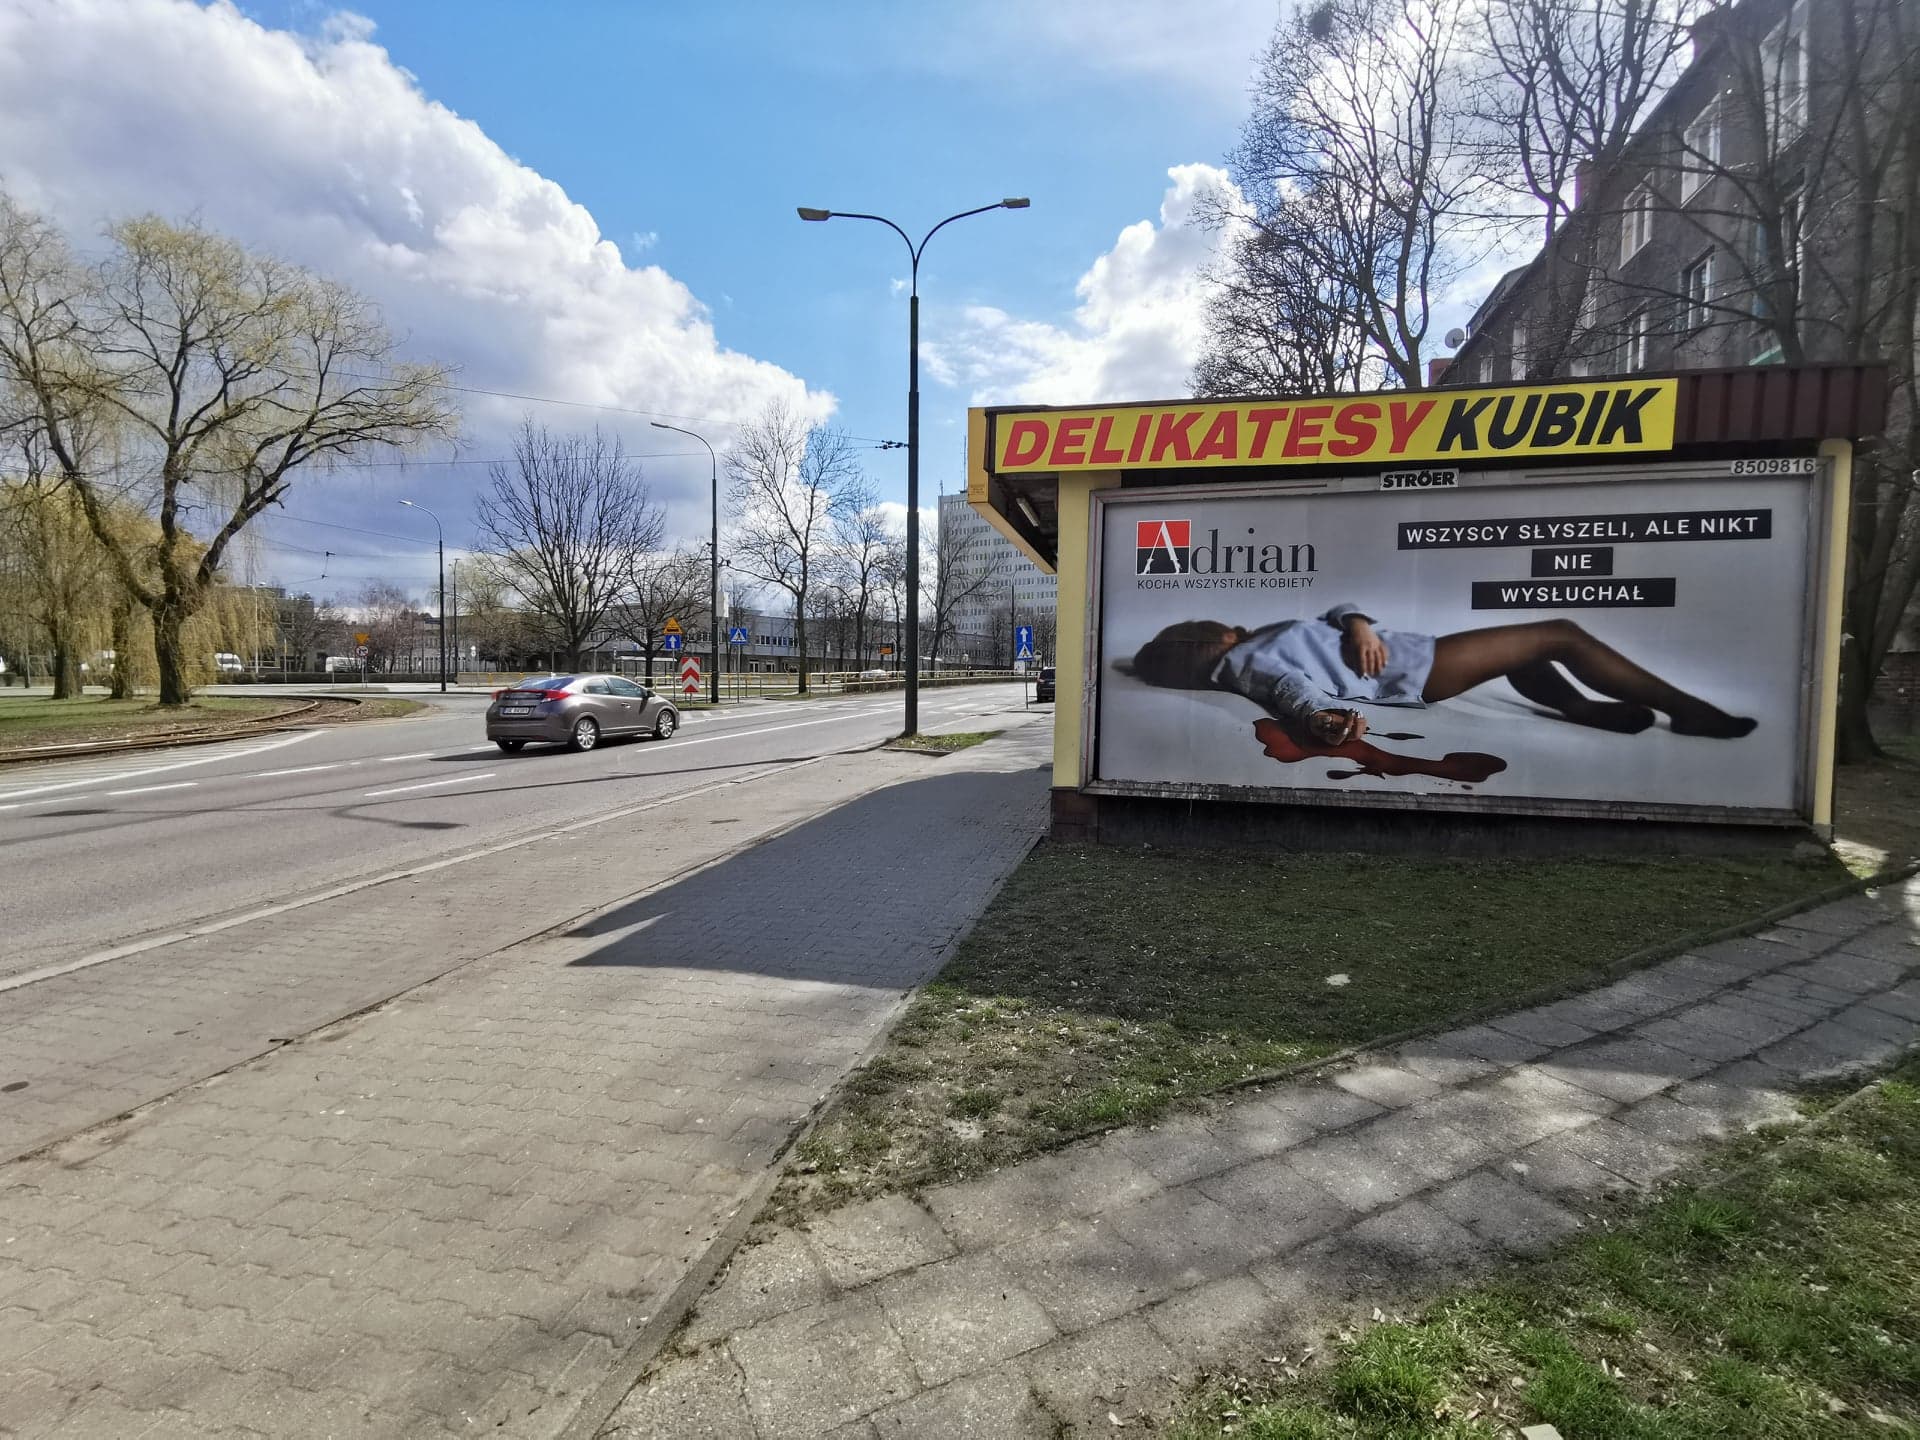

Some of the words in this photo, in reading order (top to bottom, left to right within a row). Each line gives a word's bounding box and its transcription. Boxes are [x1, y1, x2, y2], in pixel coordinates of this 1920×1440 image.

[1002, 400, 1438, 467] DELIKATESY
[1436, 387, 1663, 452] KUBIK
[1733, 458, 1815, 475] 8509816
[1406, 525, 1509, 543] WSZYSCY
[1518, 520, 1635, 540] SŁYSZELI,
[1645, 519, 1690, 535] ALE
[1701, 516, 1759, 533] NIKT
[1139, 520, 1319, 575] Adrian
[1554, 554, 1592, 570] NIE
[1137, 579, 1180, 590] KOCHA
[1184, 578, 1255, 589] WSZYSTKIE
[1260, 577, 1314, 588] KOBIETY
[1501, 585, 1645, 603] WYSŁUCHAŁ
